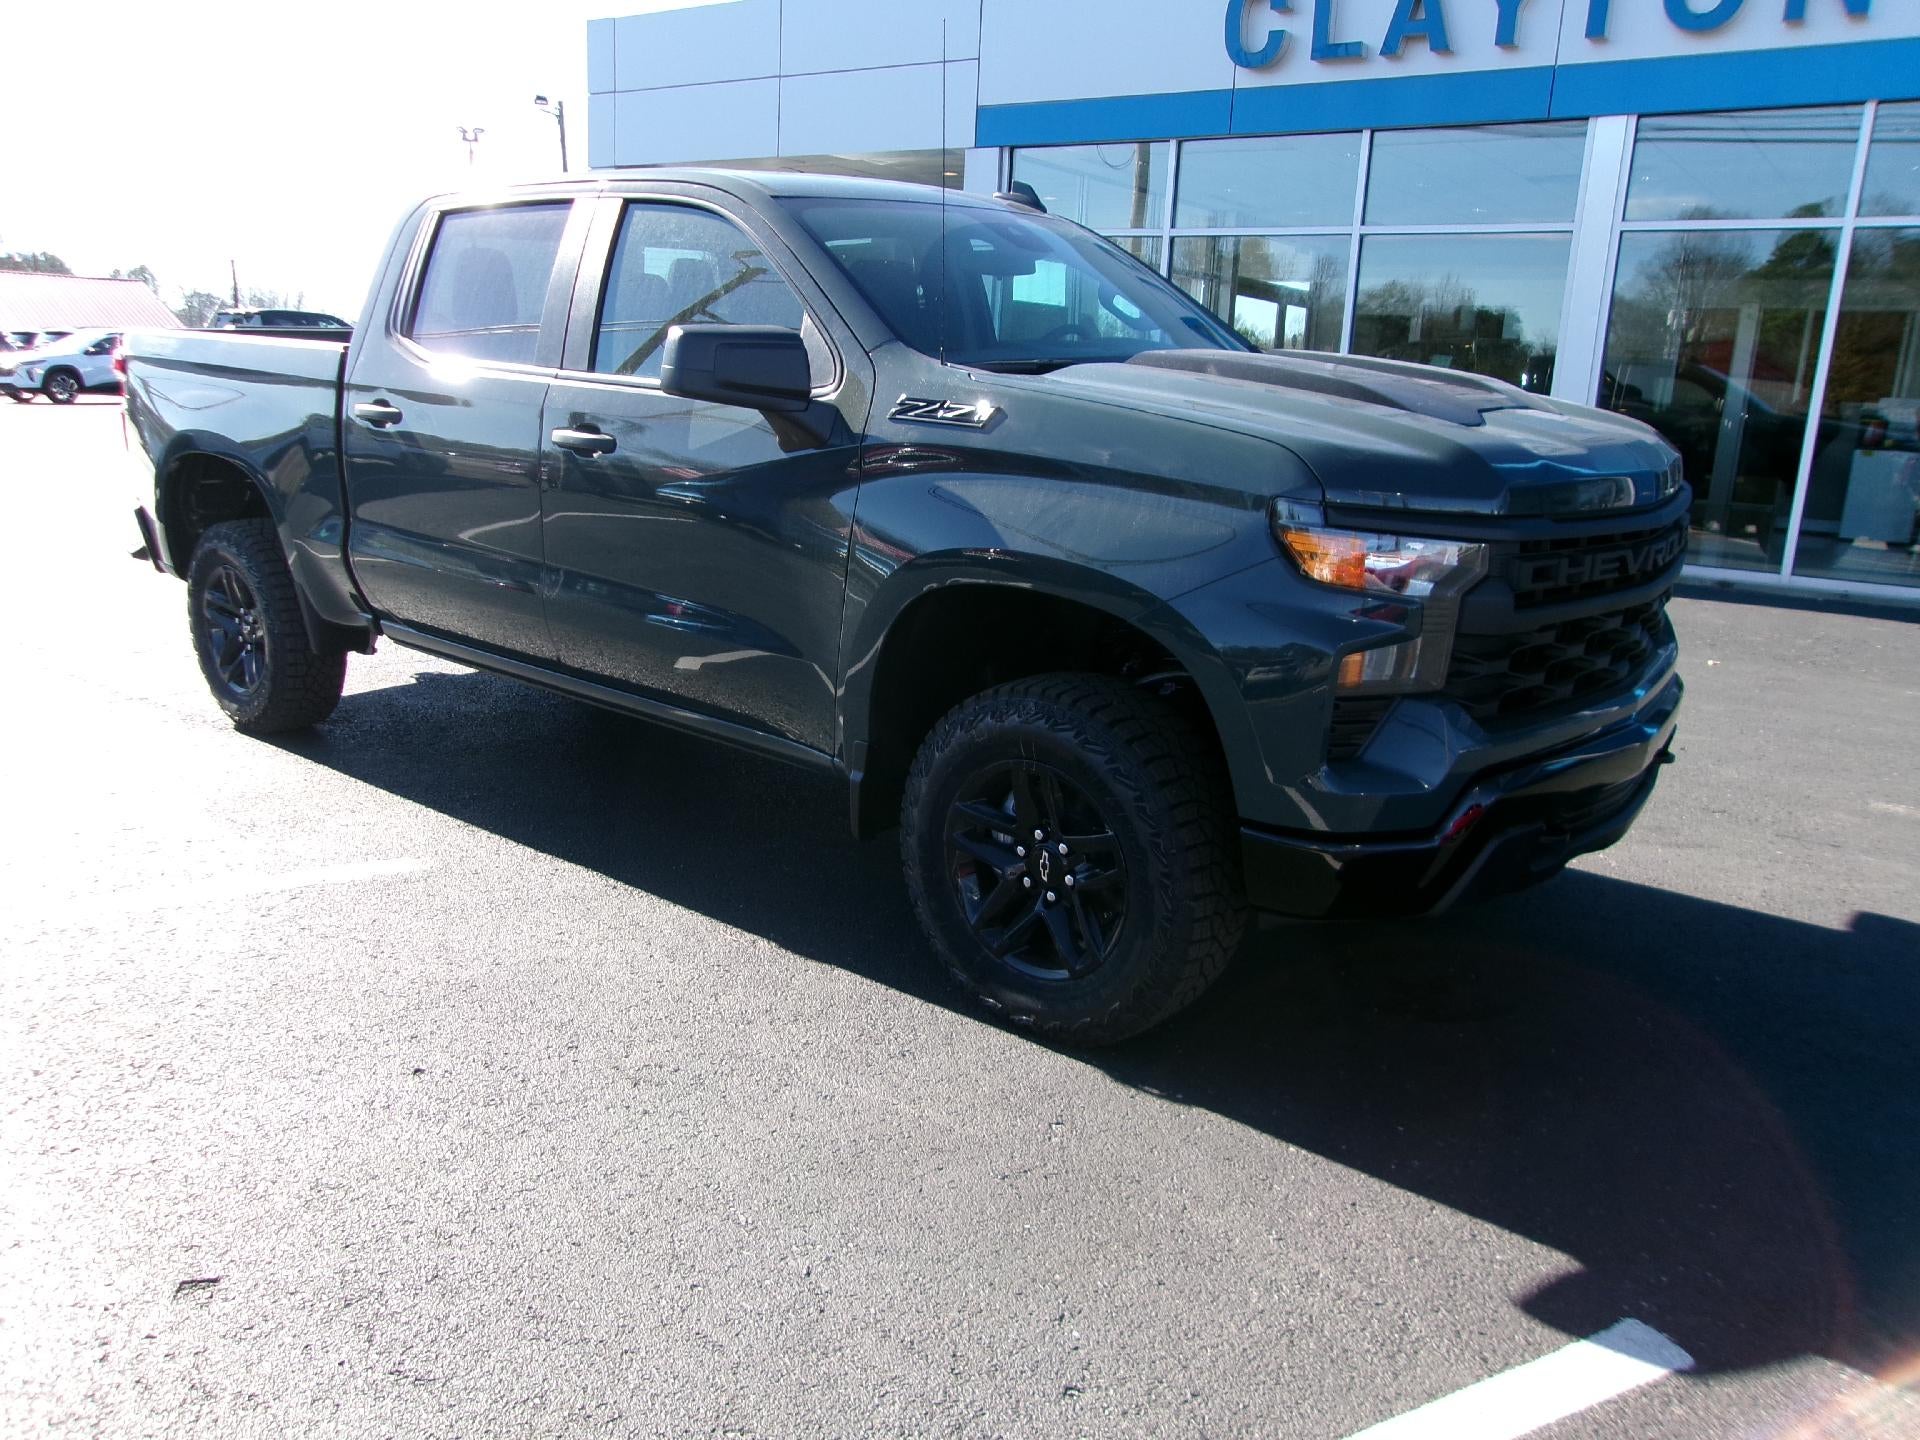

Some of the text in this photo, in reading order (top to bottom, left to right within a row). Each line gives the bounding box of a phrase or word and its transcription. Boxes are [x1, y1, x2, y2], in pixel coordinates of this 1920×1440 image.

[1224, 0, 1871, 70] CLAY
[887, 393, 1000, 428] Z71
[1523, 532, 1686, 589] CHEVRO
